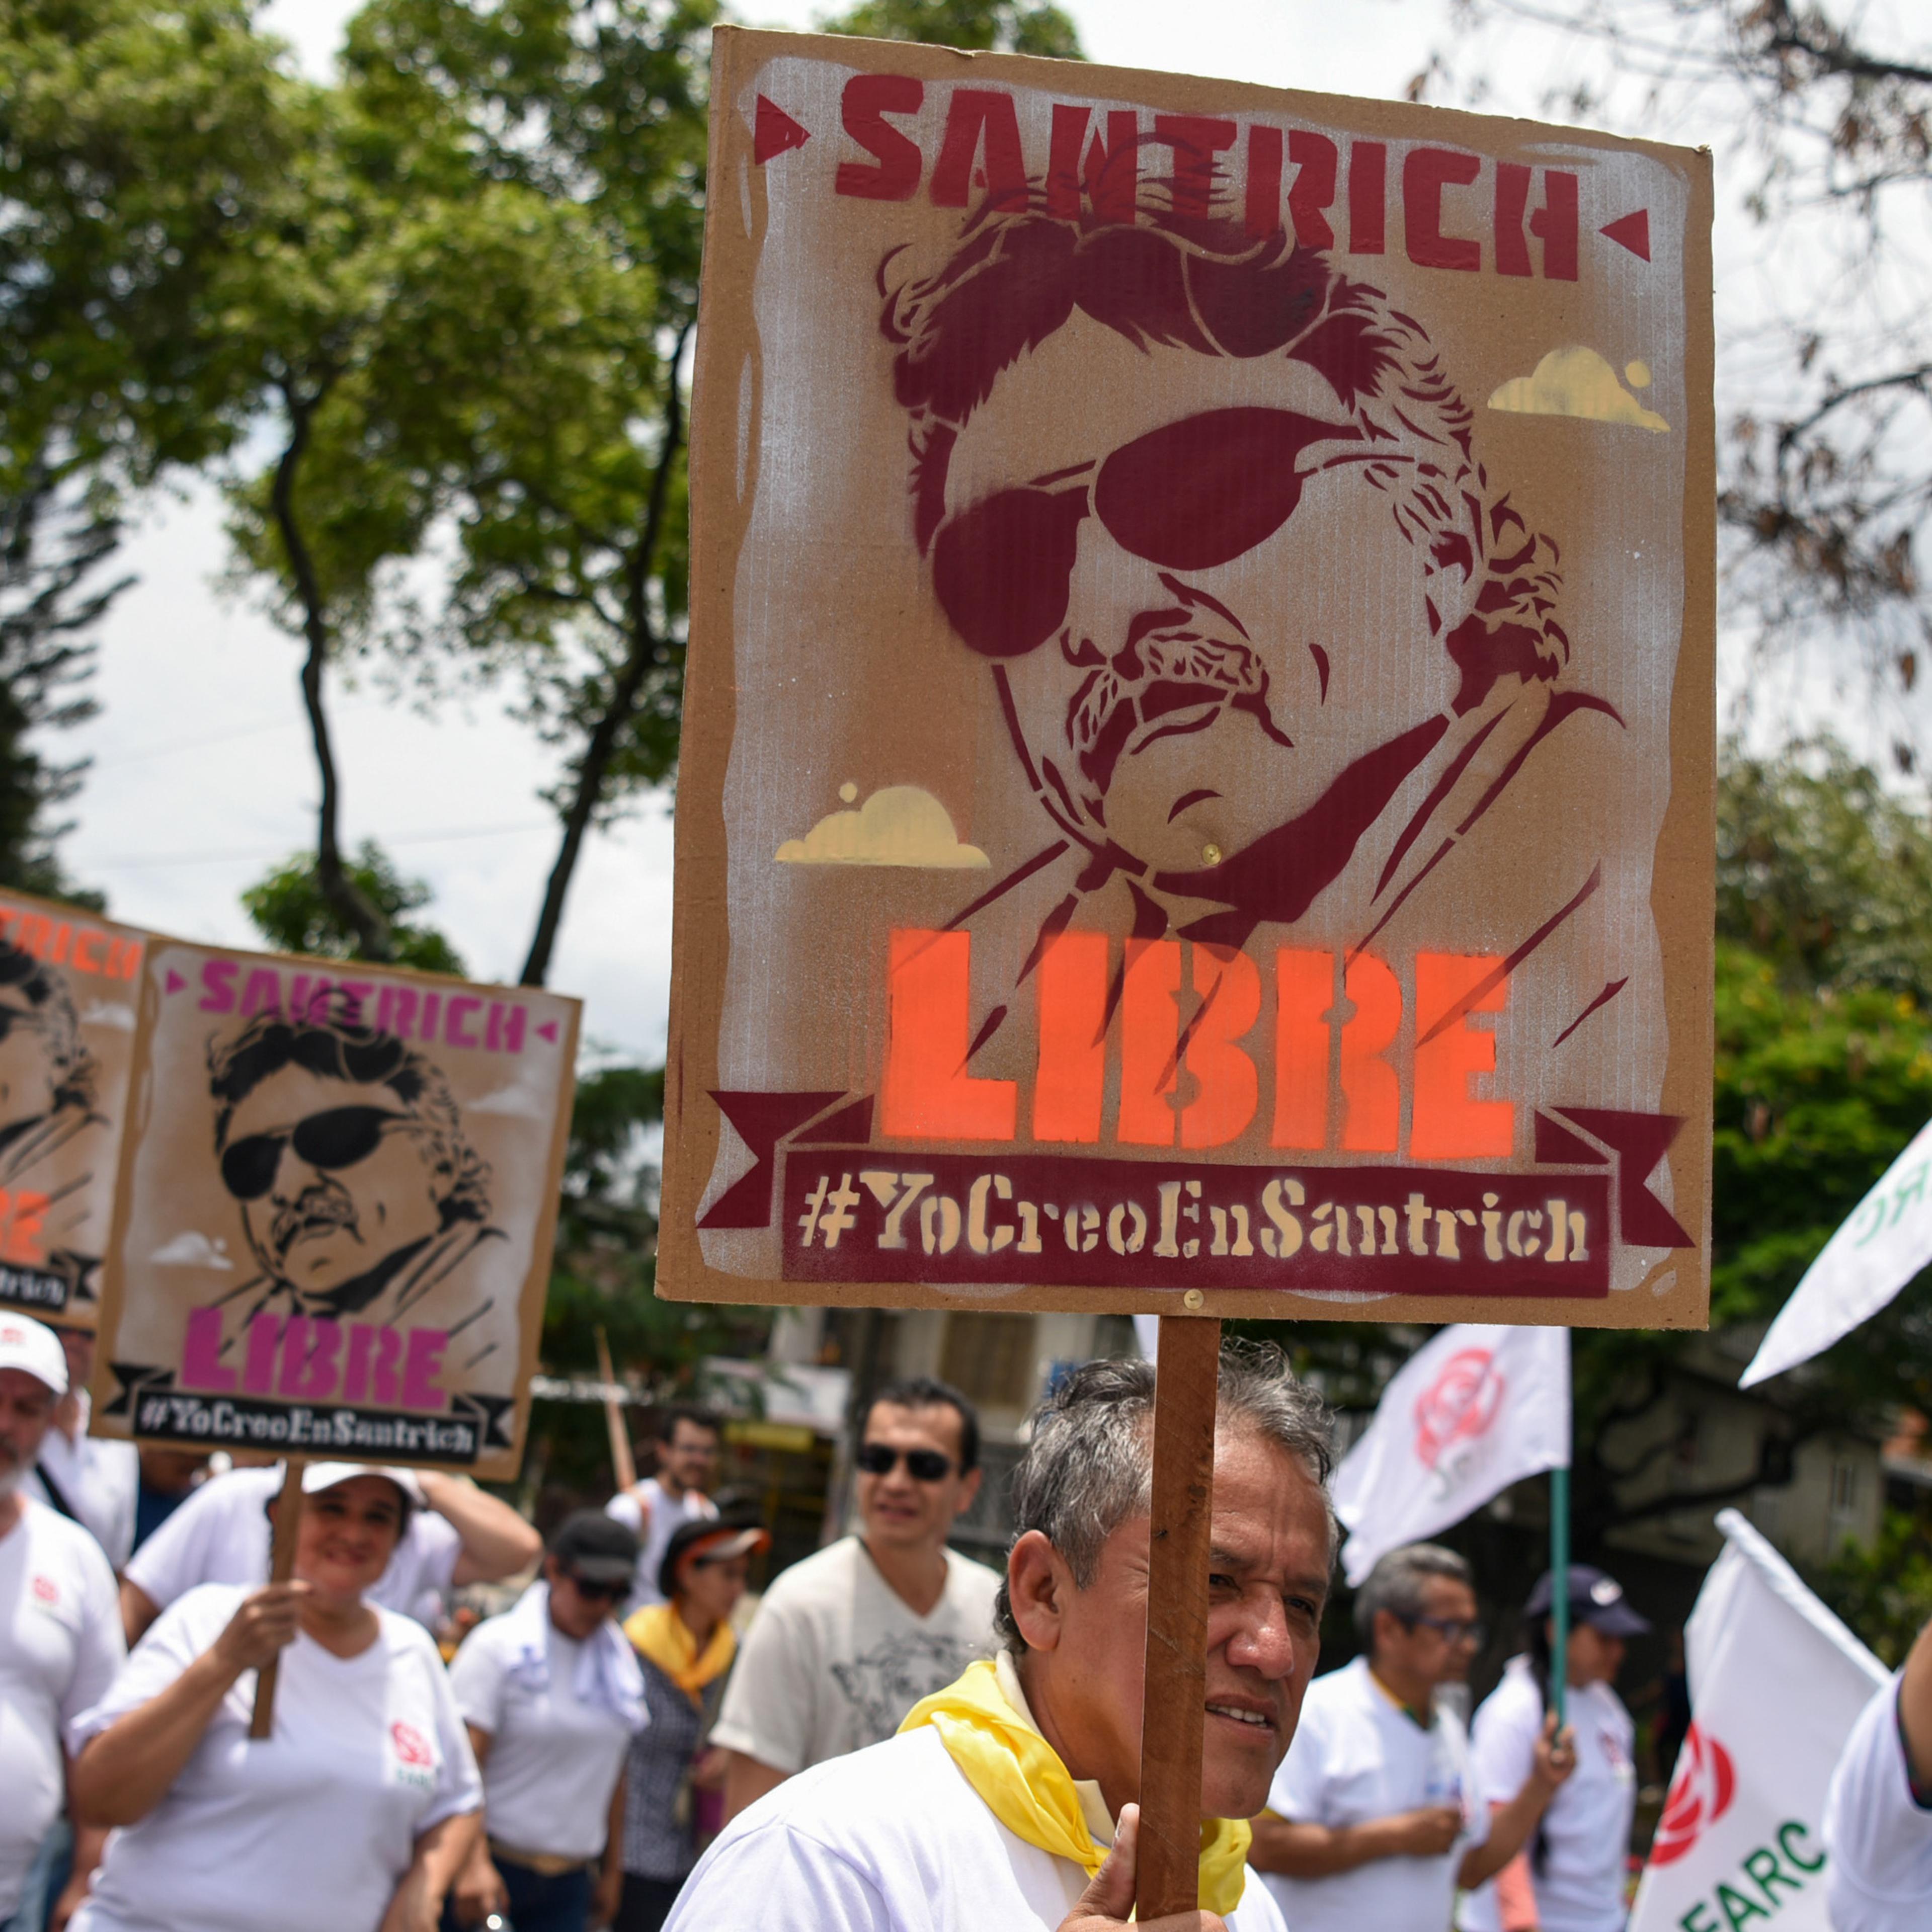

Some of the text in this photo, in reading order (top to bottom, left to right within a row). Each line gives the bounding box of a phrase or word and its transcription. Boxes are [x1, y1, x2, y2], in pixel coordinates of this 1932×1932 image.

[835, 74, 1579, 282] SANTRICH
[198, 959, 528, 1054] SANTRICH
[879, 928, 1514, 1159] LIBRE
[798, 1171, 1590, 1262] #YoCreoEnSantrich
[181, 1307, 451, 1408] LIBRE
[140, 1395, 475, 1453] #YoCreoEnSantrich
